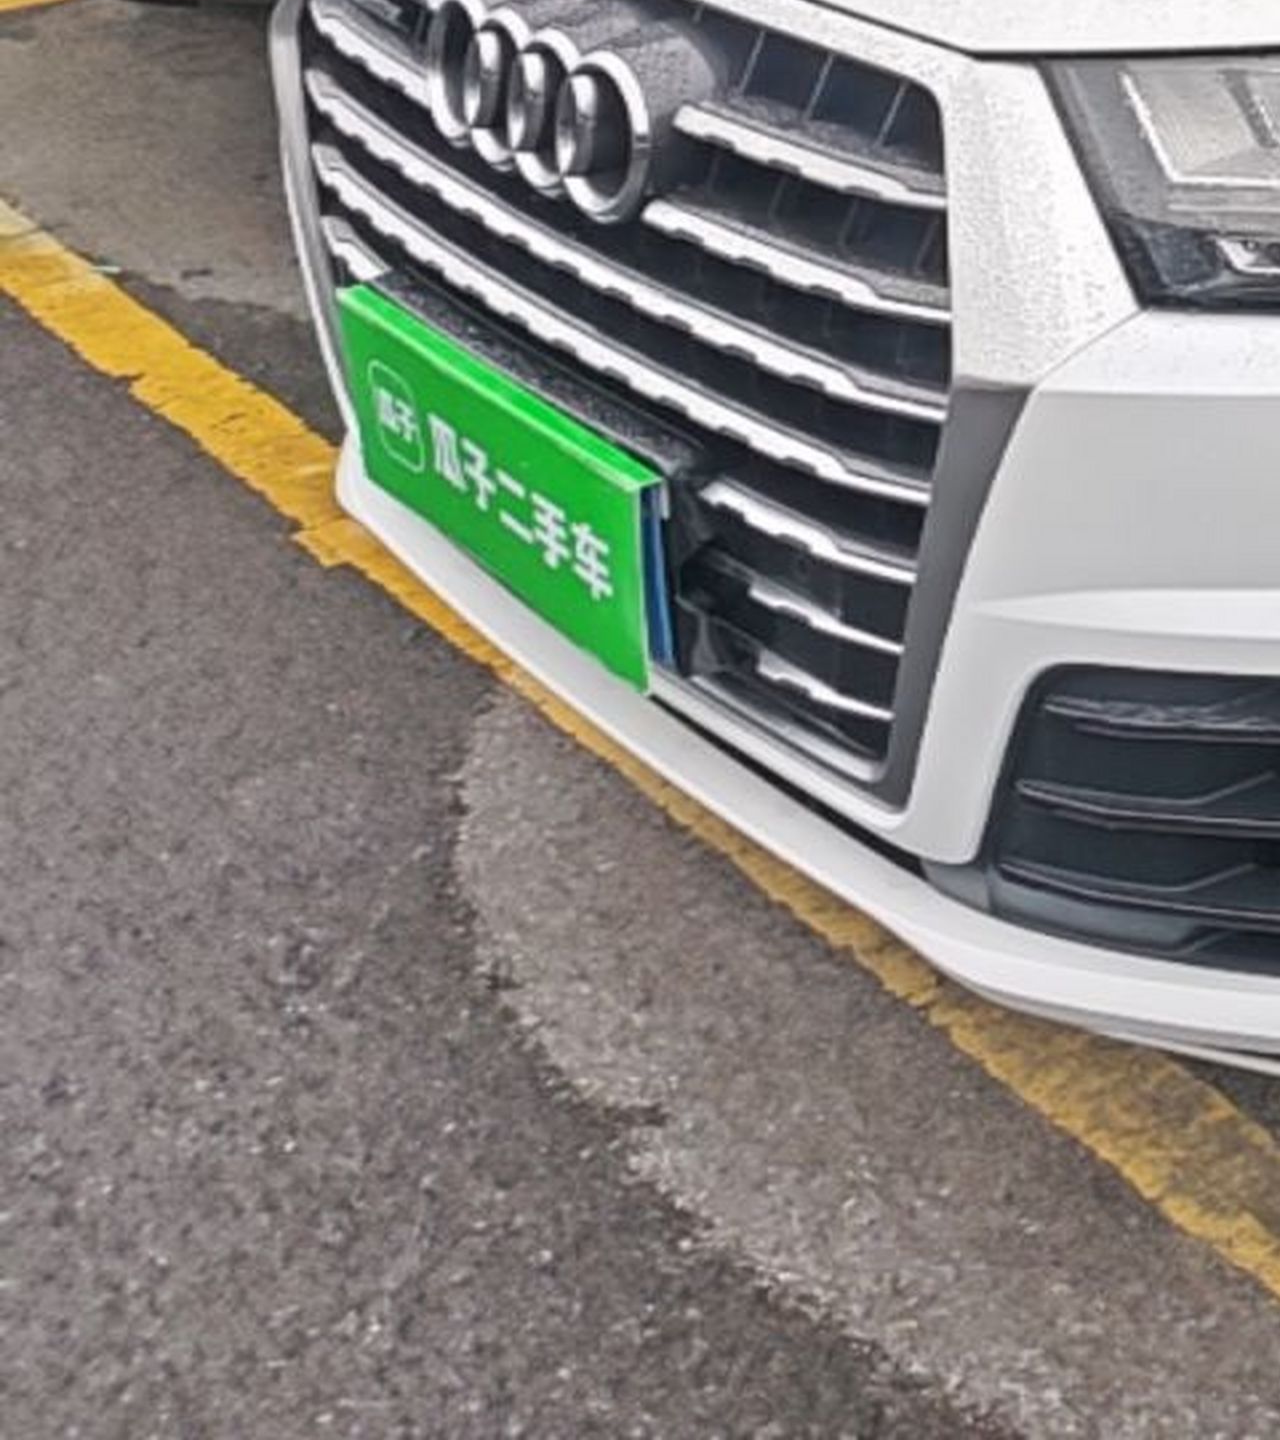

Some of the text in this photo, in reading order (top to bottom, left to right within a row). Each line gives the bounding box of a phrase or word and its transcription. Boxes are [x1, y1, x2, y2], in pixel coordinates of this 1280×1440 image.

[426, 411, 614, 601] 瓜子二手车
